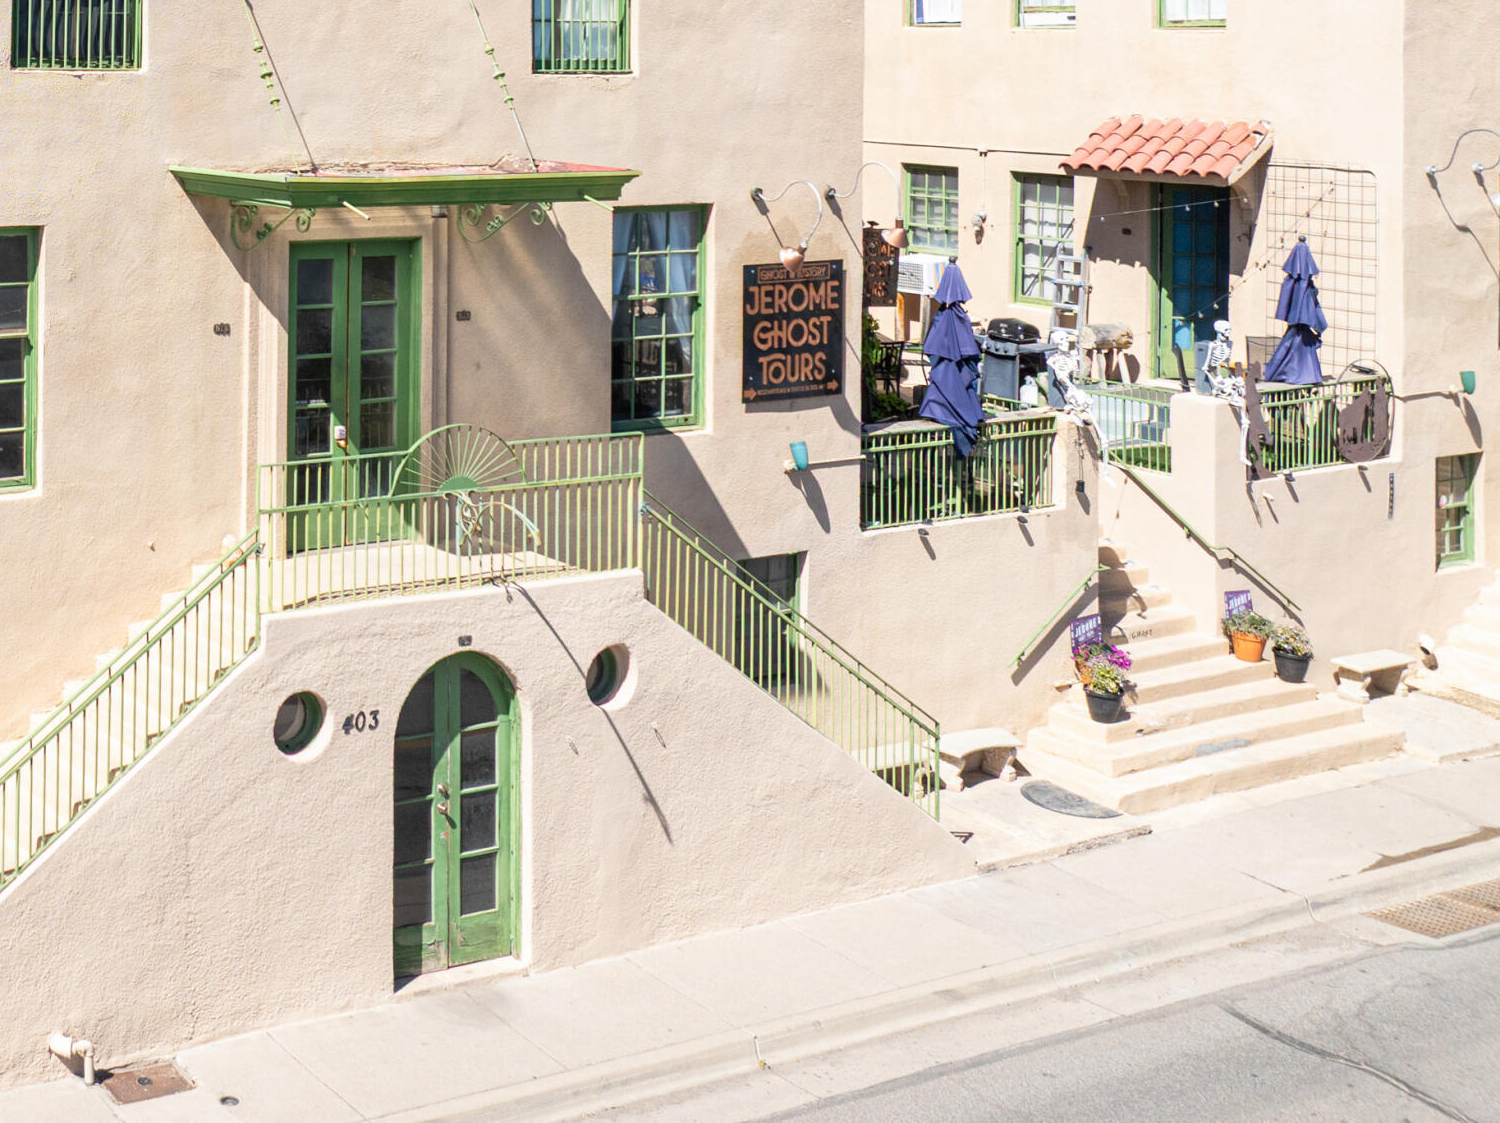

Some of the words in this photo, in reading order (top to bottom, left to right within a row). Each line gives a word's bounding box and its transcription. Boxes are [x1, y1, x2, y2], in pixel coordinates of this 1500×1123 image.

[746, 280, 840, 316] JEROME
[753, 315, 832, 351] GHOST
[758, 351, 827, 386] TOURS
[342, 709, 380, 735] 403
